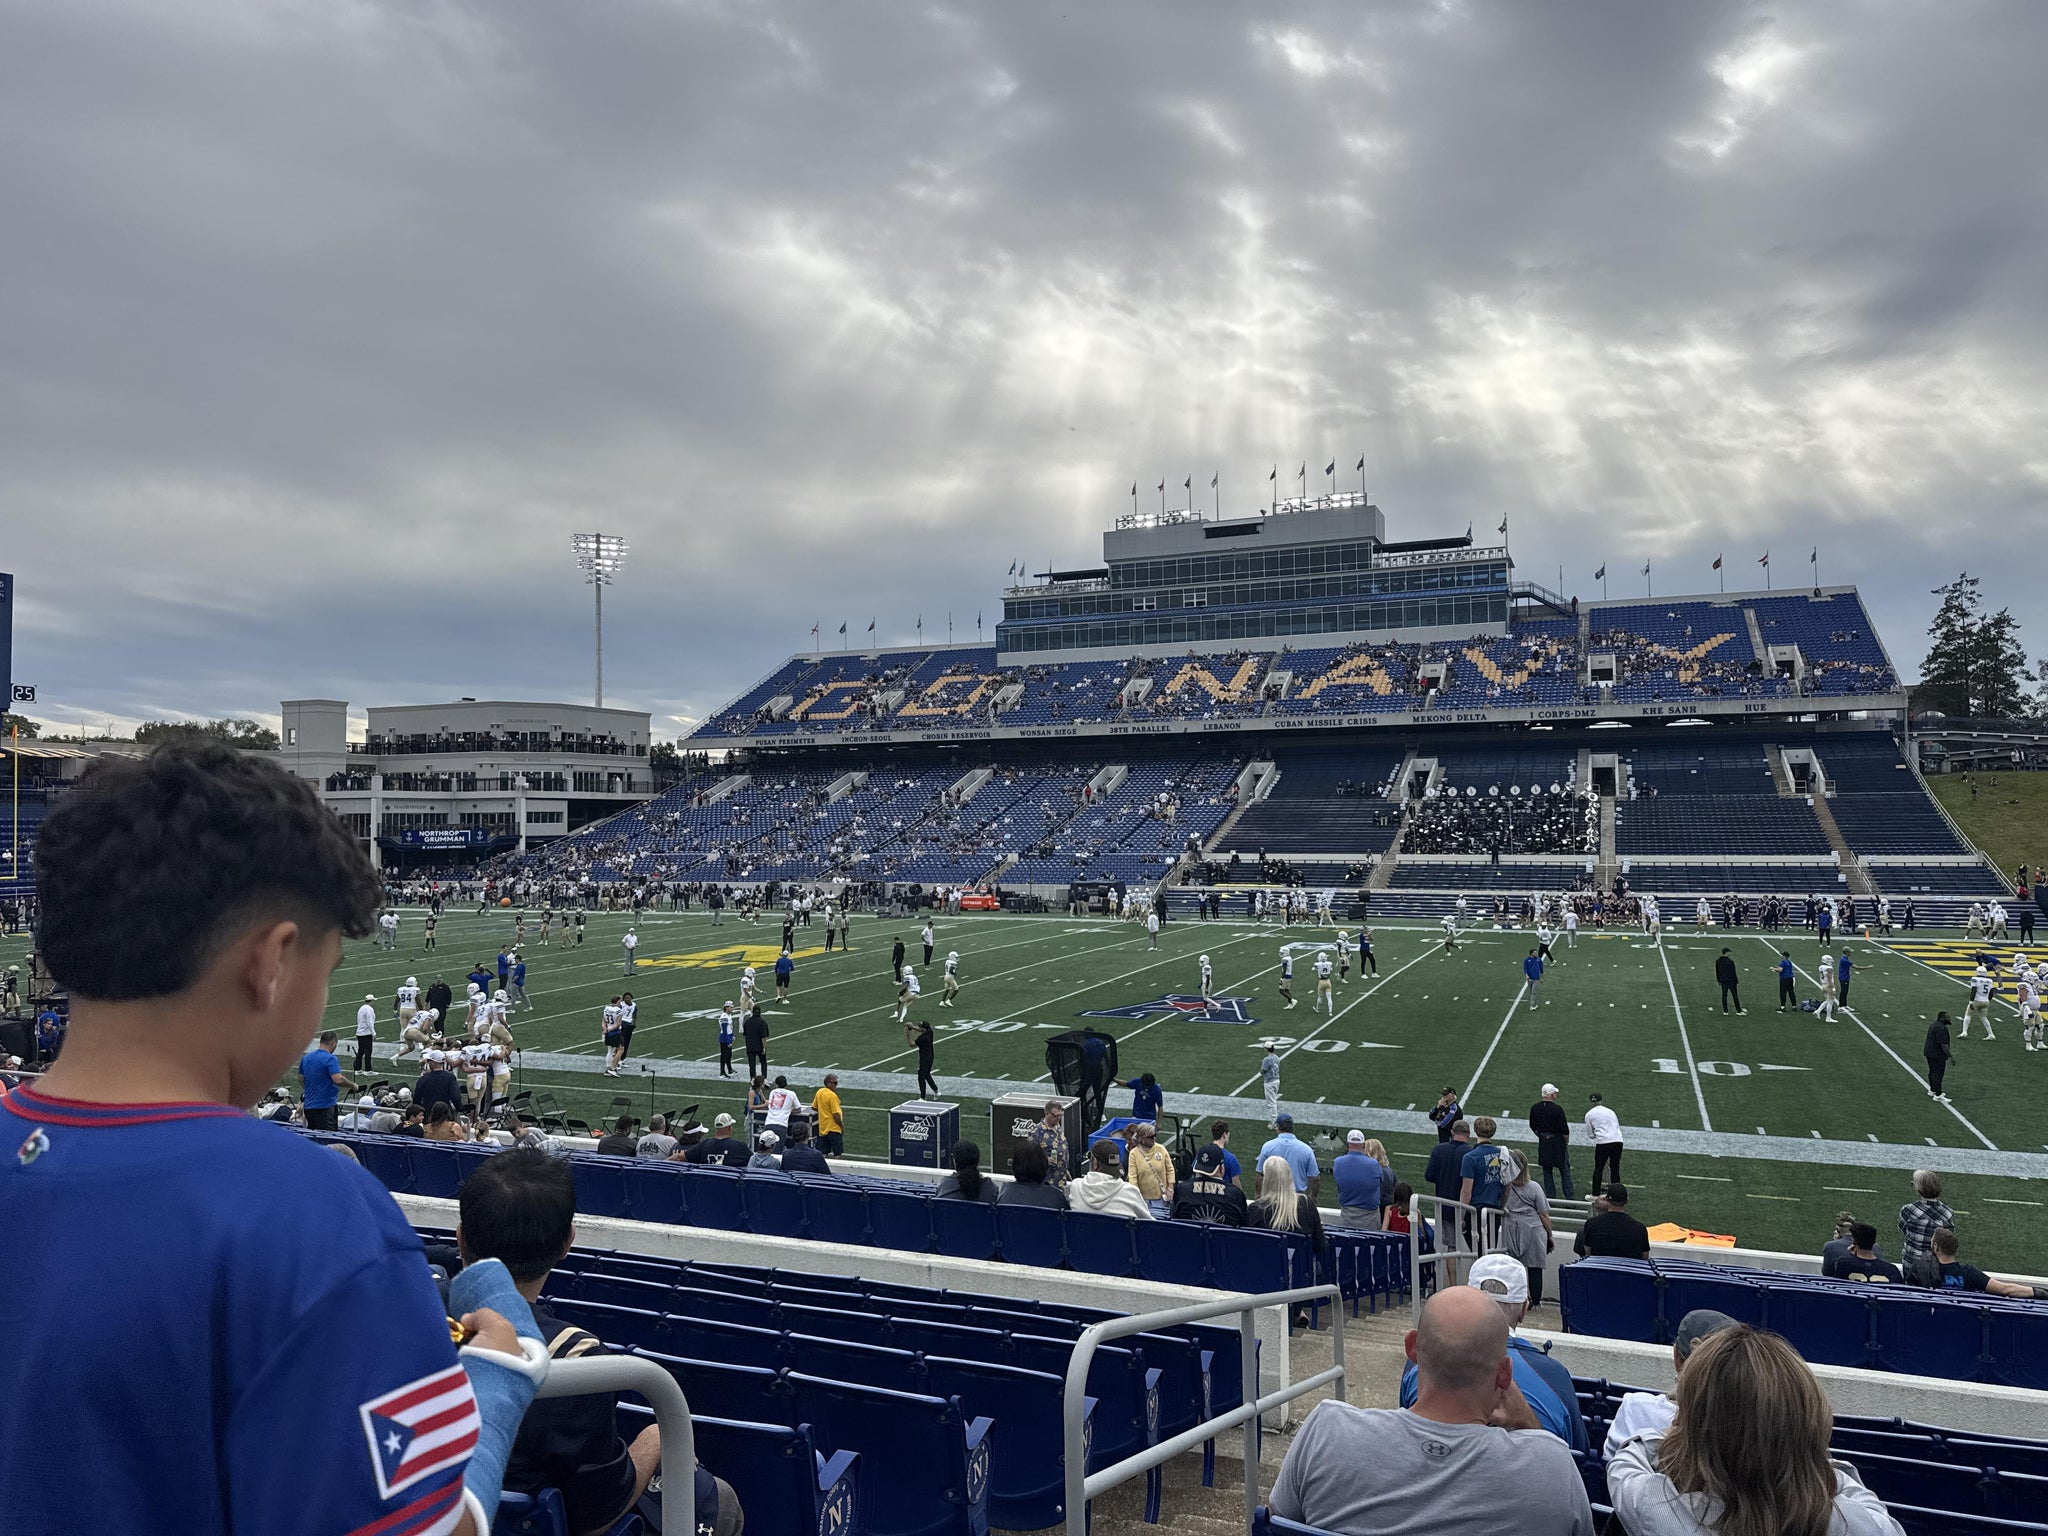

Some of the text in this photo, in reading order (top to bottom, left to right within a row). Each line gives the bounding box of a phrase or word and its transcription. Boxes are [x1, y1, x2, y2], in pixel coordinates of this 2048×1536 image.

[15, 686, 33, 700] 25
[1642, 706, 1697, 715] KHE SANH
[1744, 703, 1768, 711] HUE
[1412, 713, 1487, 723] MEKONG DELTA
[1537, 709, 1597, 718] CORPS-DMZ
[1203, 722, 1242, 731] LEBANON
[1274, 717, 1378, 728] CUBAN MISSILE CRISIS
[1019, 728, 1077, 737] WONSAN SIEGE
[1109, 725, 1172, 734] 38TH PARALLEL
[778, 737, 816, 745] PERIMETER
[841, 735, 892, 743] INCHON-SEOUL
[921, 731, 992, 741] CHOSIN RESERVOIR
[1982, 984, 1989, 994] 5
[605, 1014, 615, 1025] 33
[934, 1019, 1028, 1033] 30
[1247, 1036, 1350, 1053] 20
[1650, 1058, 1752, 1077] 10
[900, 1121, 929, 1133] Tulsa
[1192, 1181, 1226, 1195] NAVY
[973, 1455, 983, 1486] N
[828, 1496, 843, 1535] N
